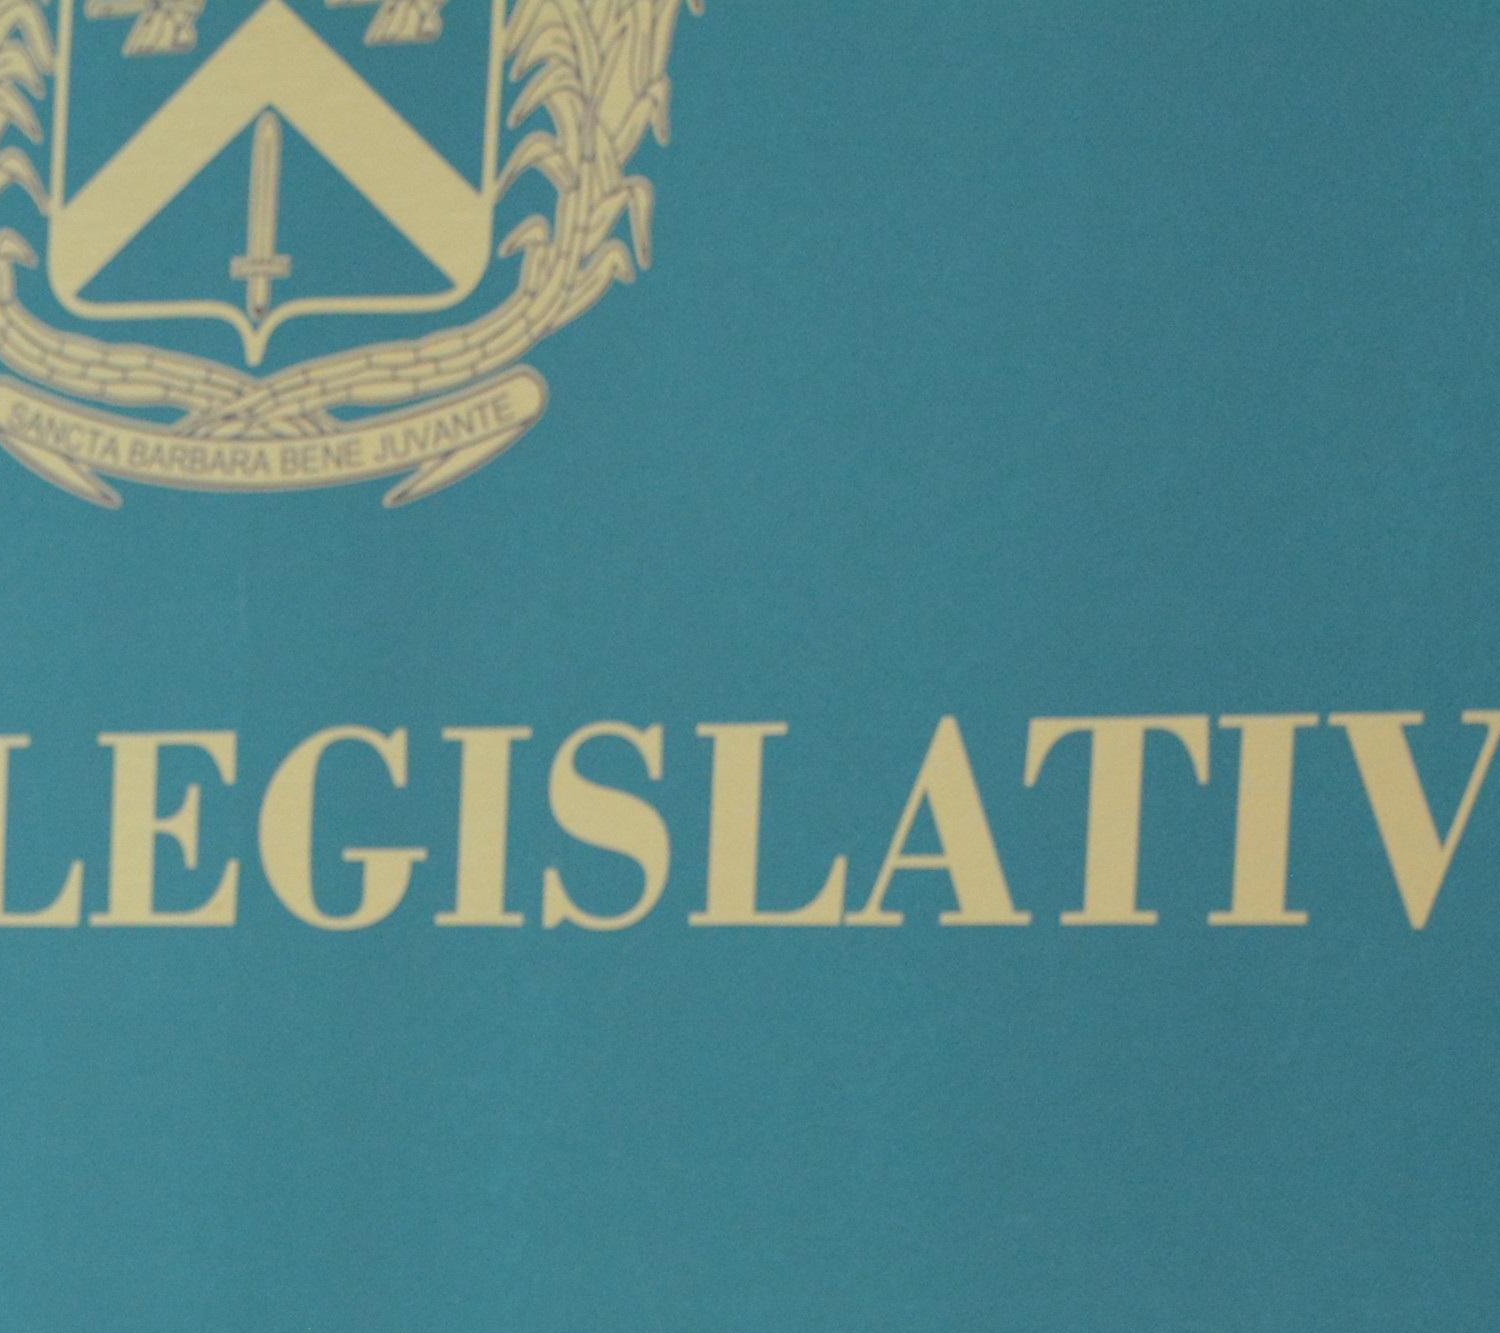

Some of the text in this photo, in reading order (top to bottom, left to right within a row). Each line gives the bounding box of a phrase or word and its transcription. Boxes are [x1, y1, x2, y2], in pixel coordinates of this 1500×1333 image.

[6, 392, 516, 477] SANCTA BARBARA BENE JUVANTE
